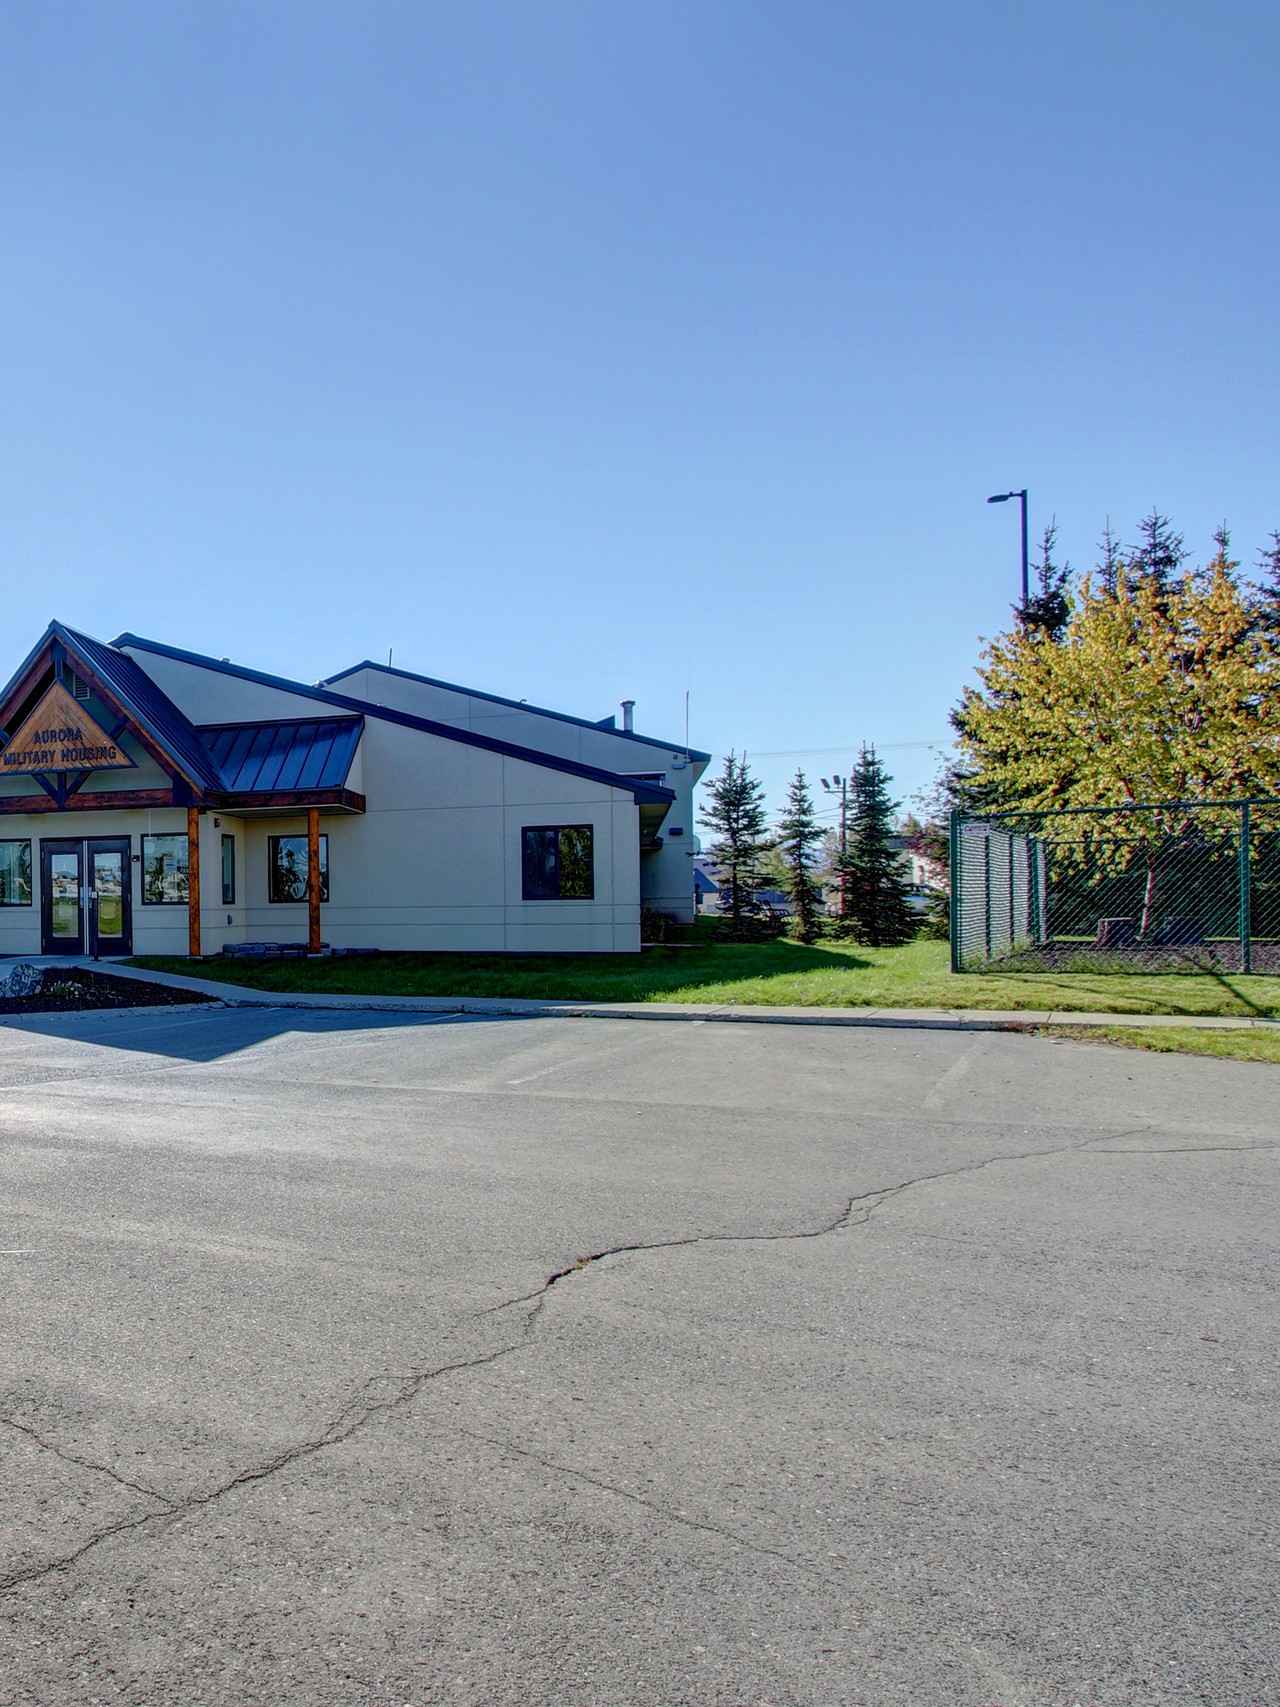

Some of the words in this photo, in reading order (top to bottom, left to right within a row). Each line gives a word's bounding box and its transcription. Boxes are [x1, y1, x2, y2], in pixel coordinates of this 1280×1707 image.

[33, 727, 82, 743] AURORA
[4, 750, 55, 765] MILITARY
[61, 747, 116, 762] HOUSING
